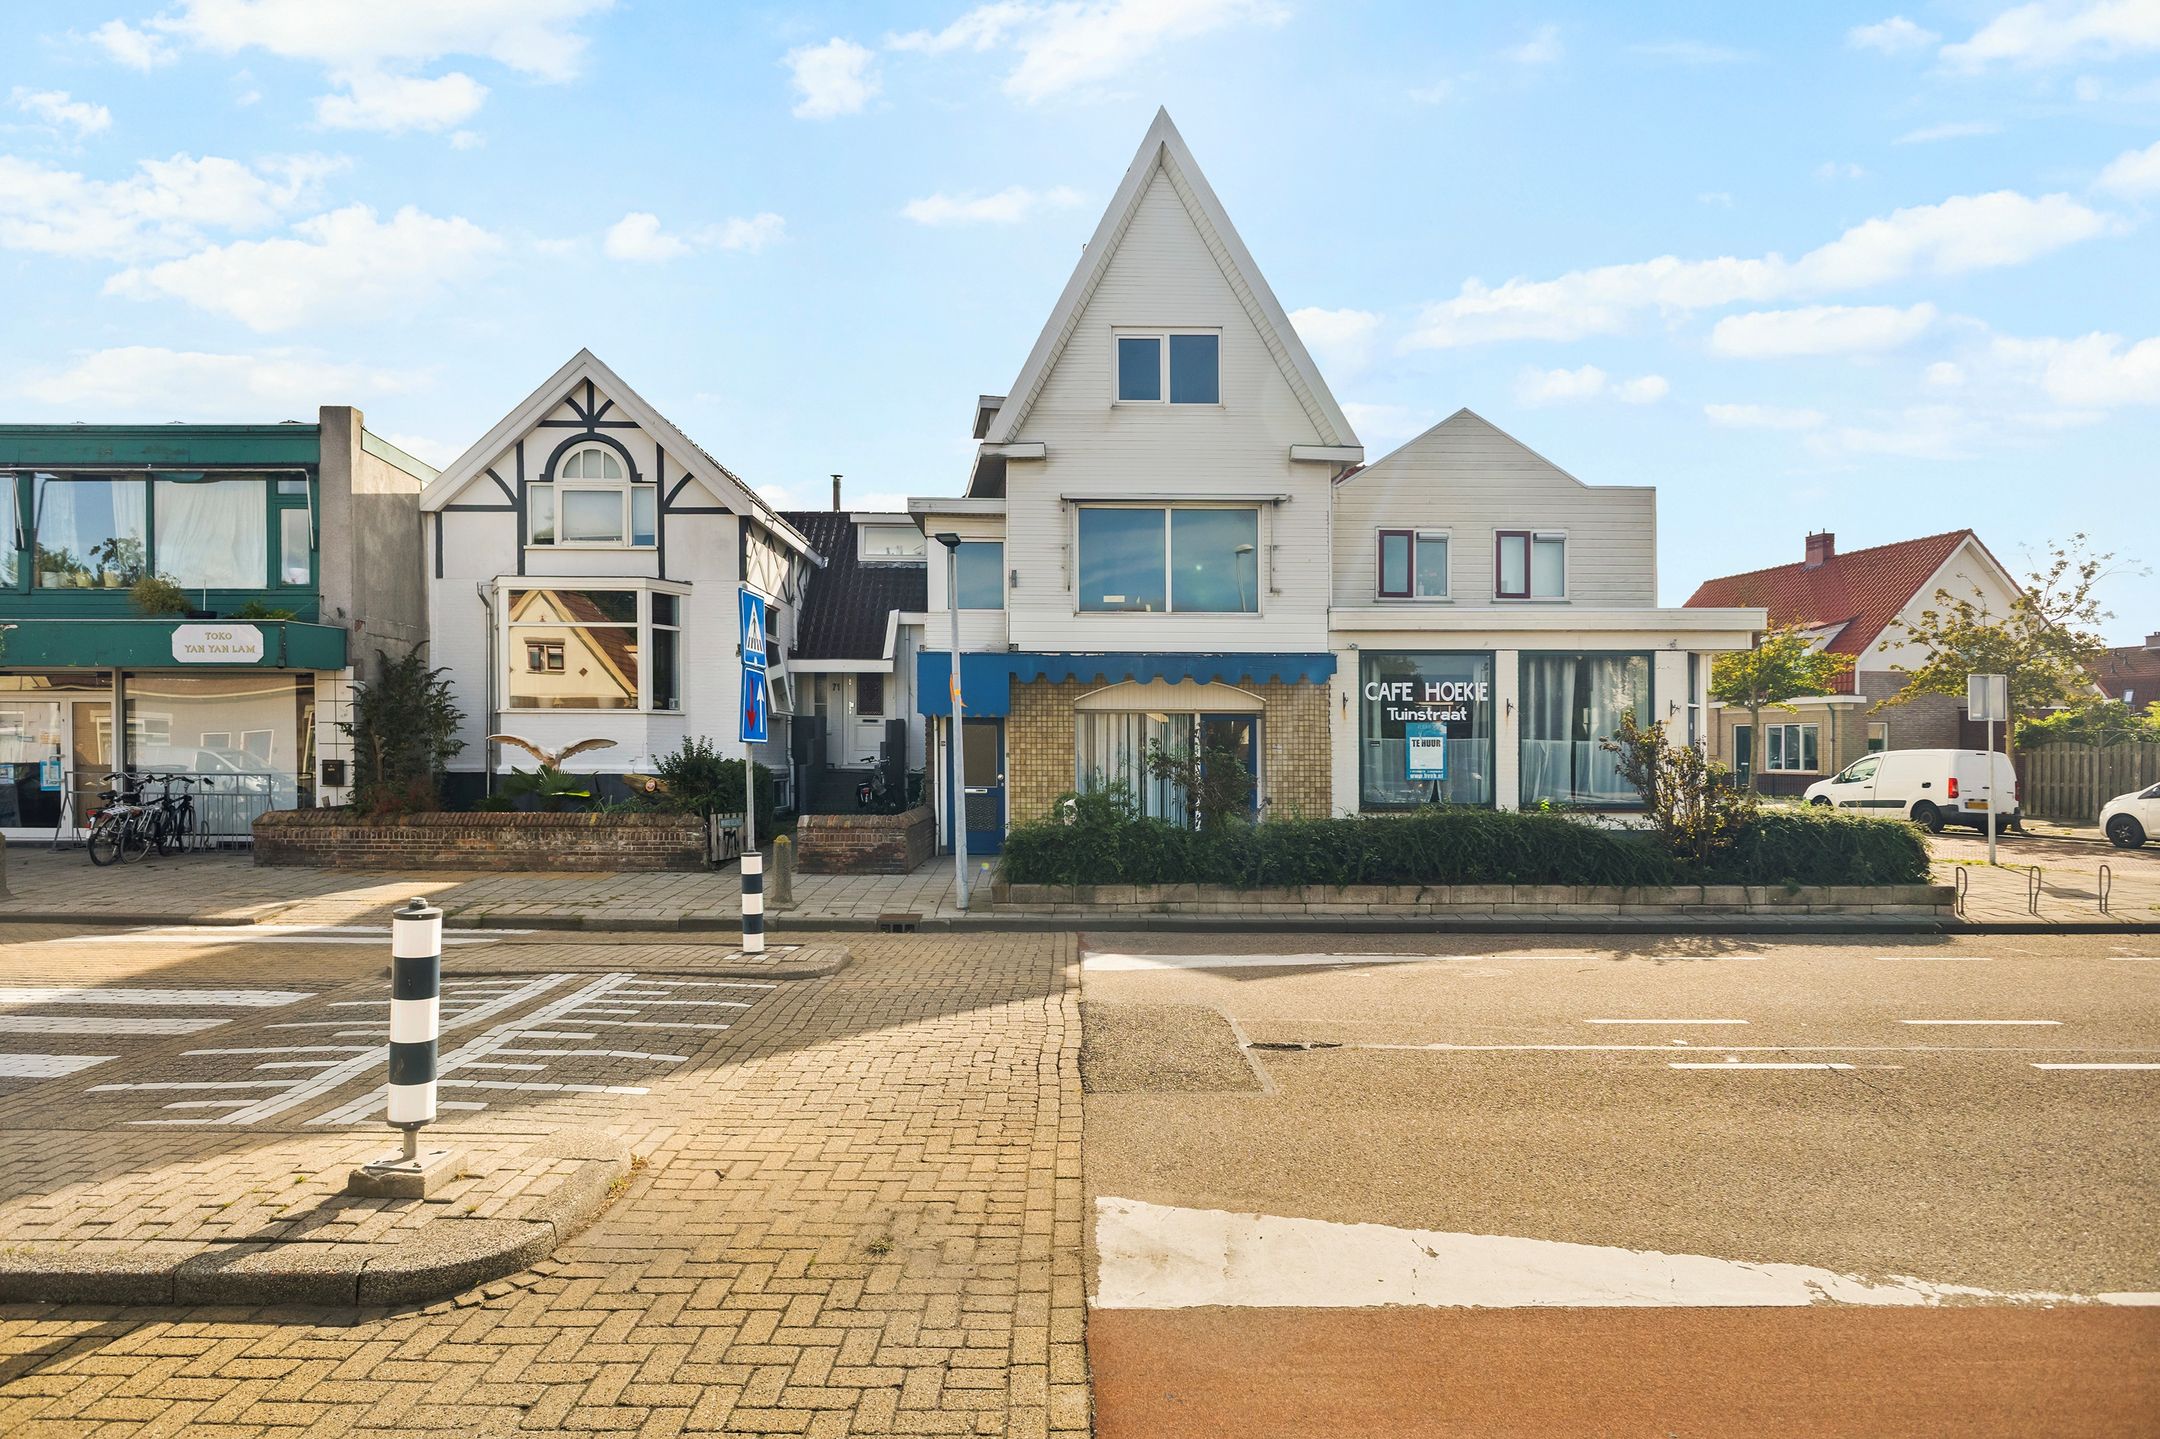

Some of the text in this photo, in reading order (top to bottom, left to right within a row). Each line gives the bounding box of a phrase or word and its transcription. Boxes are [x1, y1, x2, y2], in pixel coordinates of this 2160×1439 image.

[205, 632, 232, 640] TOKO
[185, 645, 255, 653] YAN YAN LAM
[832, 682, 841, 692] 71
[1365, 682, 1488, 701] CAFE HOEKIE
[1386, 706, 1468, 721] Tuinstraat
[1411, 739, 1441, 748] TE HUUR
